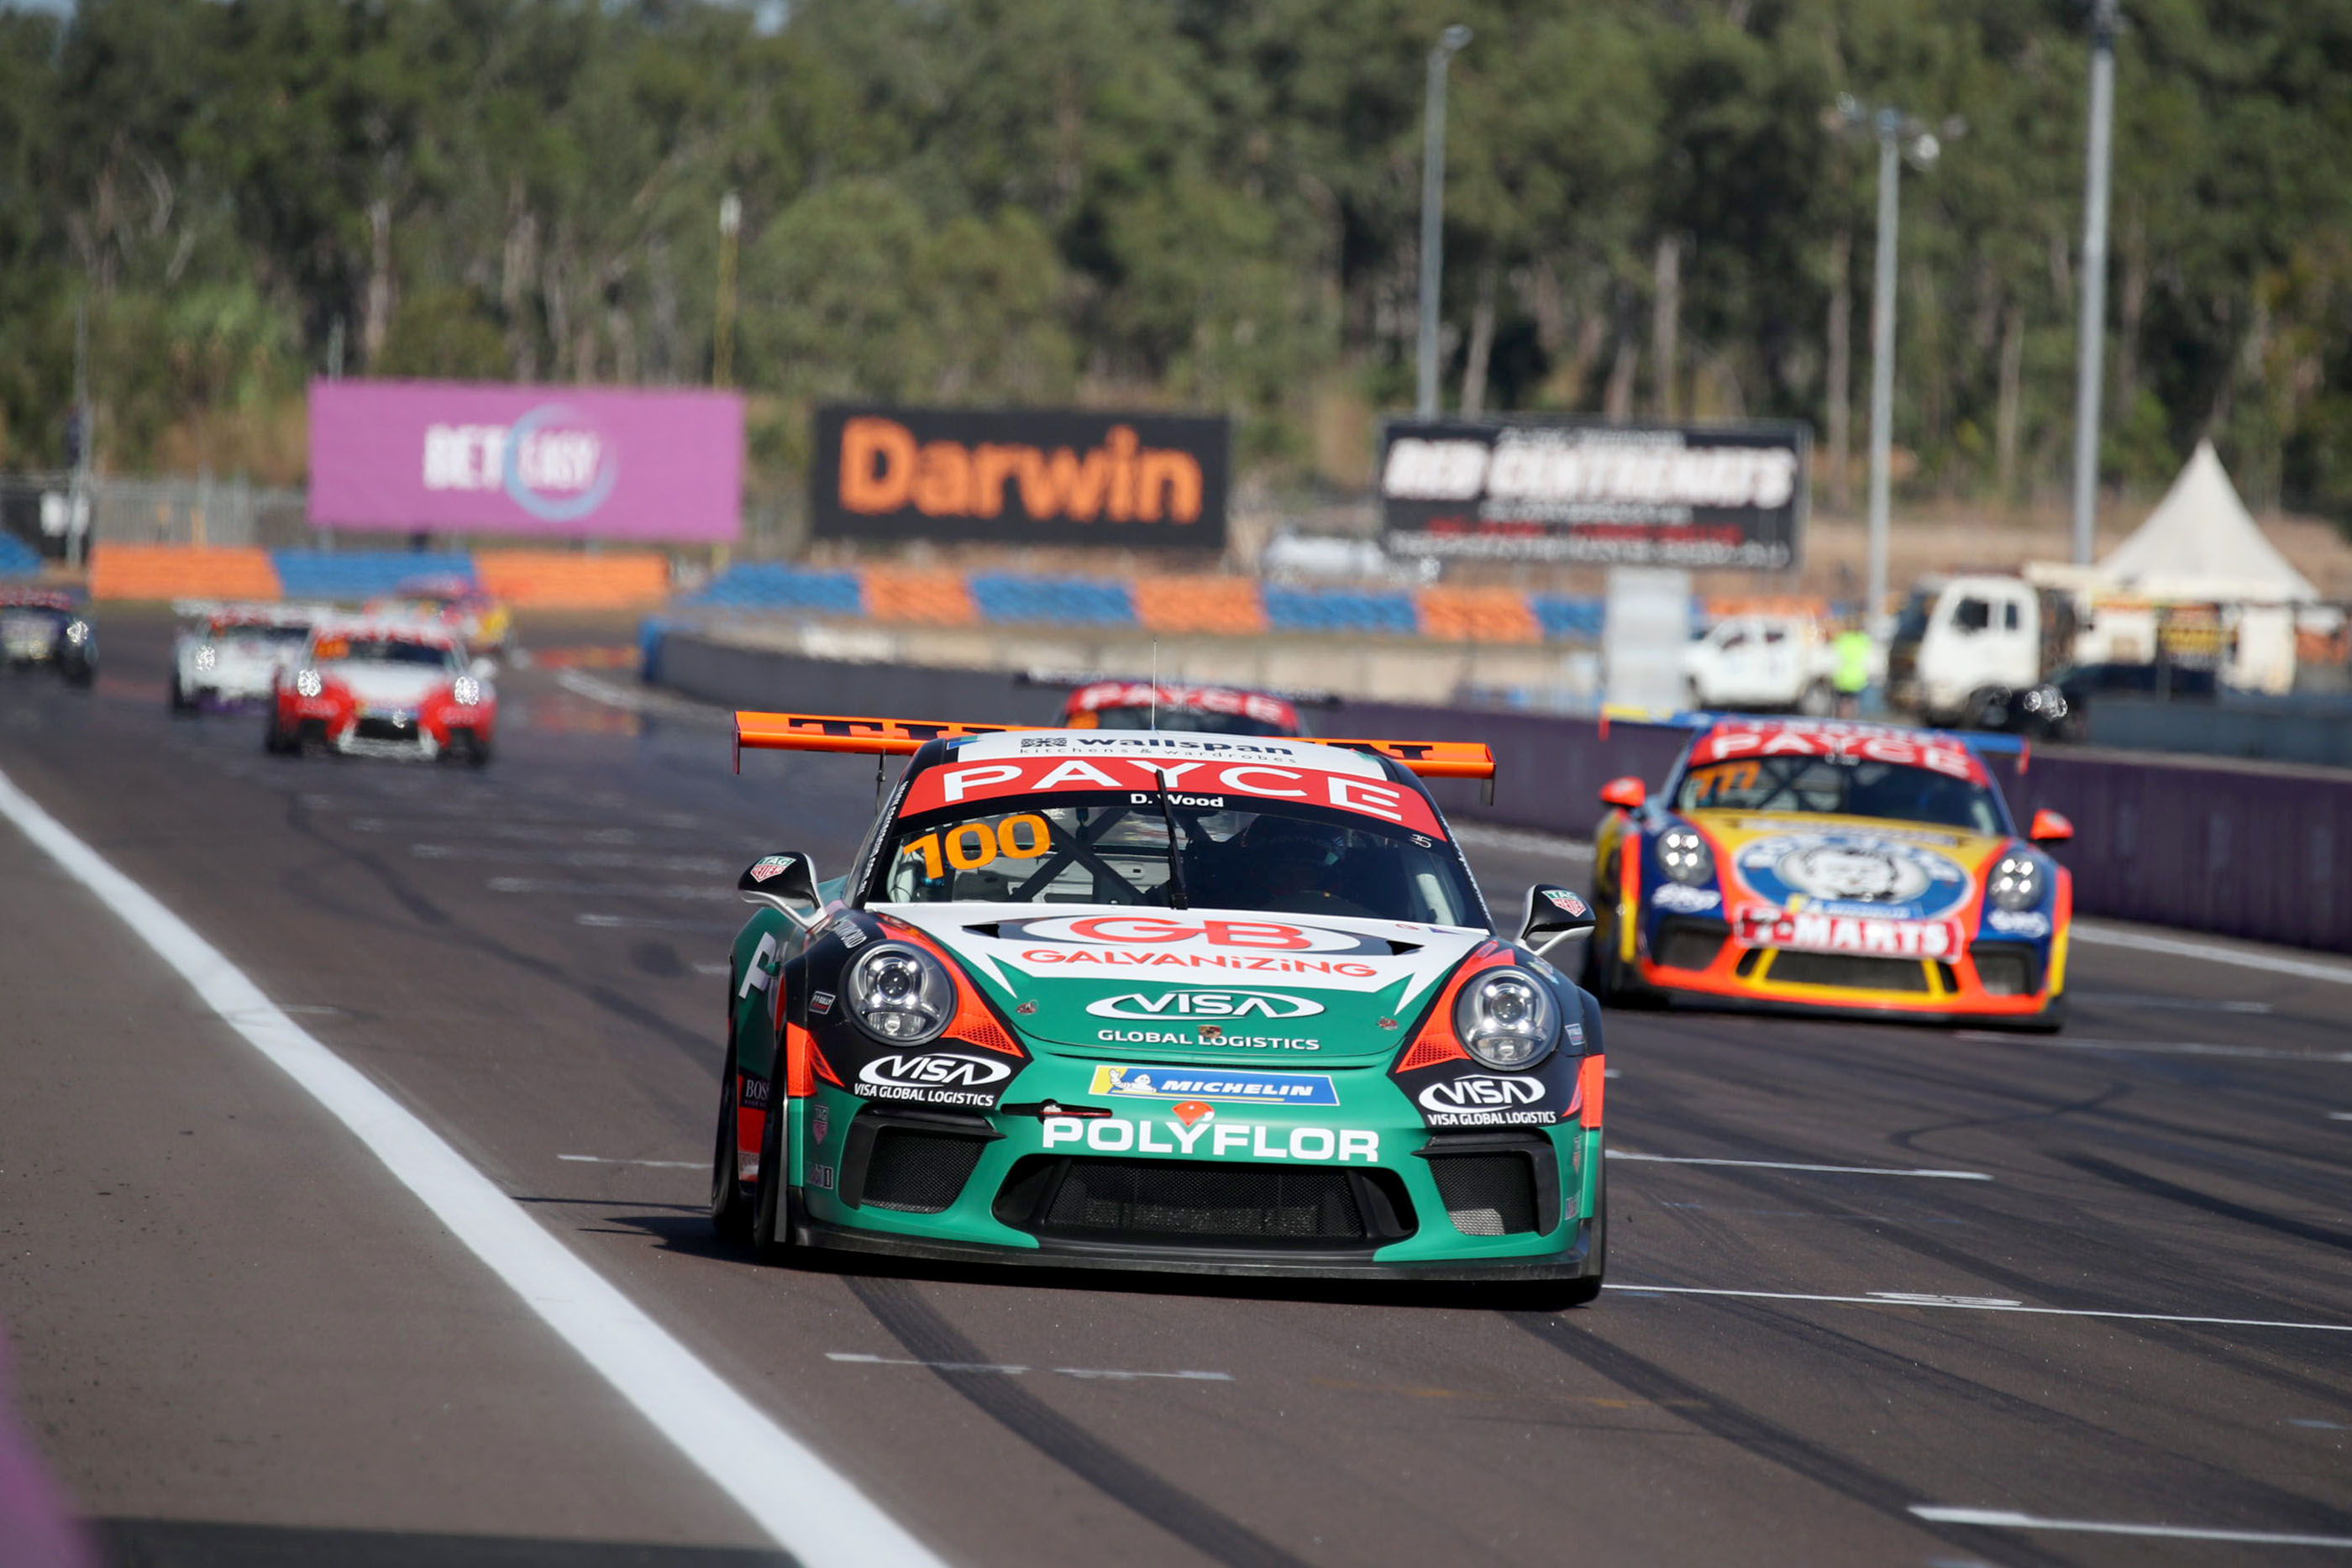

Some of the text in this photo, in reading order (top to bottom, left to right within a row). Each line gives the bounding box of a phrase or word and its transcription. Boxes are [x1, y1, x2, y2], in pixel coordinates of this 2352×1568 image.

[841, 417, 1203, 523] Darwin
[1077, 738, 1293, 755] wallspan
[1164, 750, 1297, 763] wardrobes
[1712, 733, 1972, 779] PAYCE
[943, 760, 1404, 821] PAYCE
[1130, 793, 1153, 805] D.
[903, 814, 1051, 879] 100
[753, 865, 783, 879] HEUER
[758, 857, 794, 867] TAG
[1069, 916, 1311, 949] GB
[1131, 994, 1278, 1018] VISA
[1098, 1030, 1320, 1050] GLOBAL LOGISTICS
[890, 1055, 975, 1085] VISA
[854, 1083, 995, 1106] VISA GLOBAL LOGISTICS
[1161, 1080, 1314, 1096] MICHELIN
[1428, 1111, 1557, 1125] VISA GLOBAL LOGISTICS
[1042, 1117, 1379, 1162] POLYFLOR
